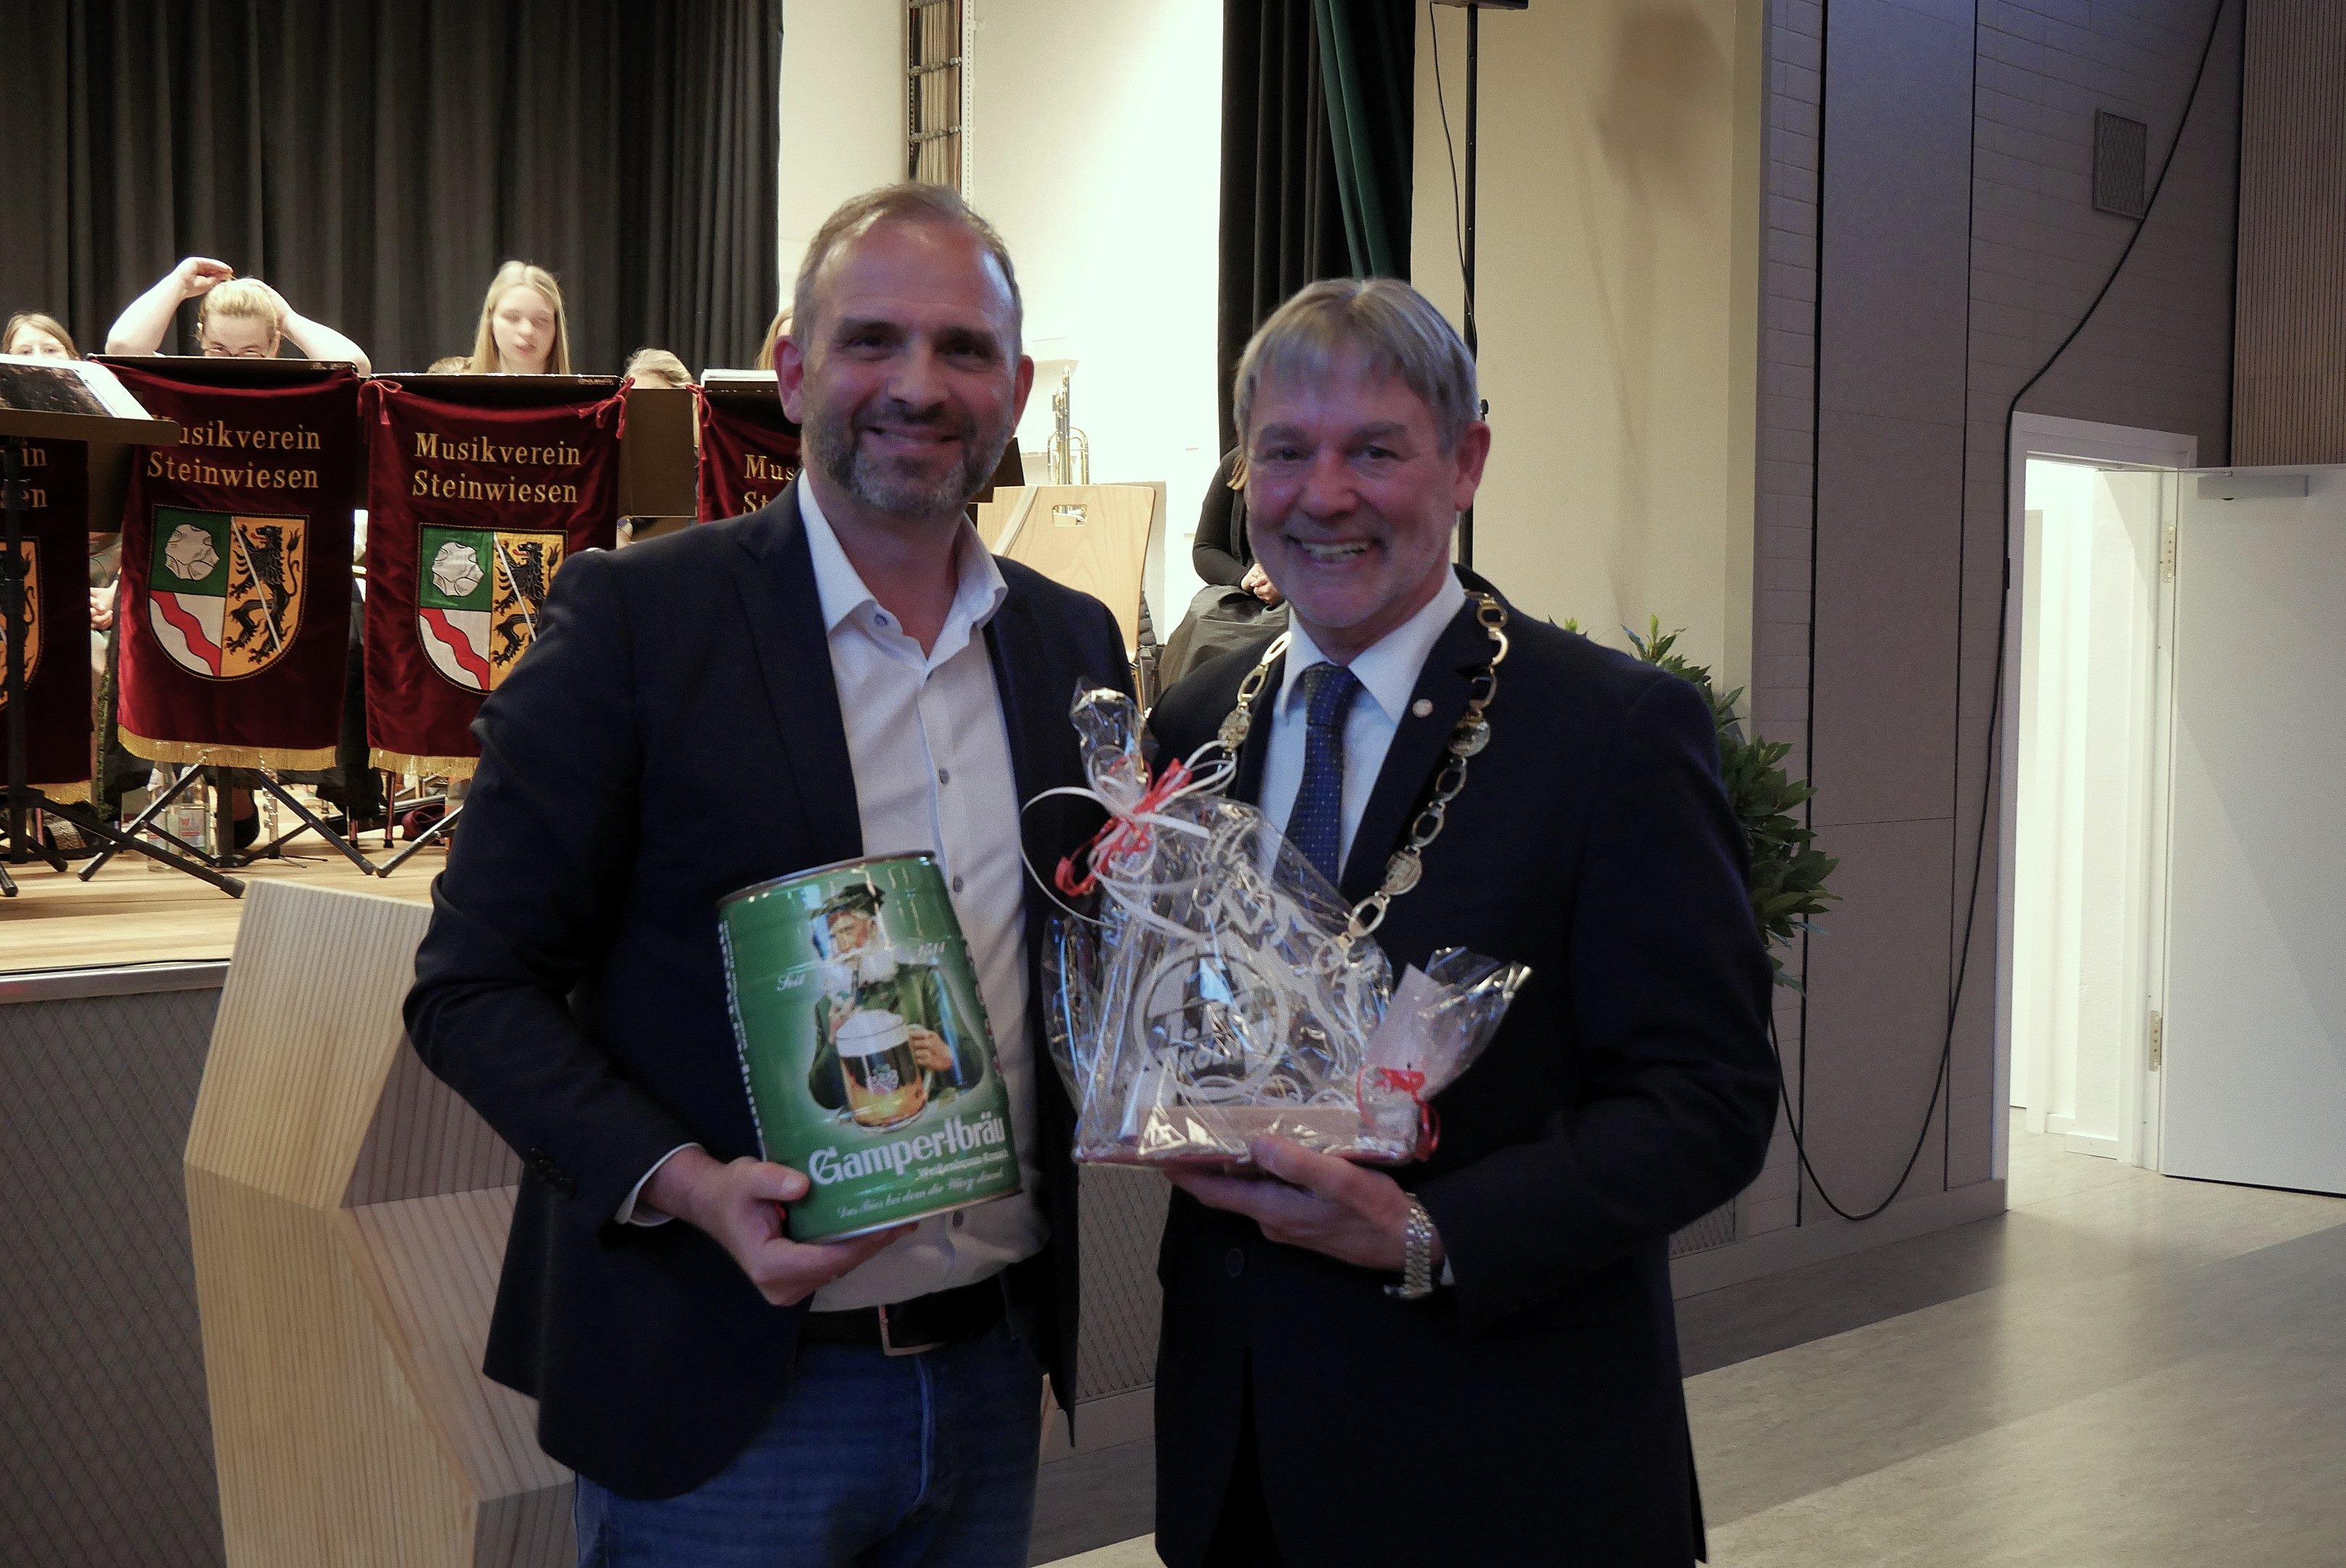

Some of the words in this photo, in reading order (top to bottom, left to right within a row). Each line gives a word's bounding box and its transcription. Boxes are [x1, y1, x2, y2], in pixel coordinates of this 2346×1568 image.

[150, 415, 321, 450] usikverein
[414, 432, 581, 465] Musikverein
[147, 450, 319, 489] Steinwiesen
[743, 454, 796, 481] Mus
[412, 469, 579, 504] Steinwiesen
[742, 490, 769, 515] St
